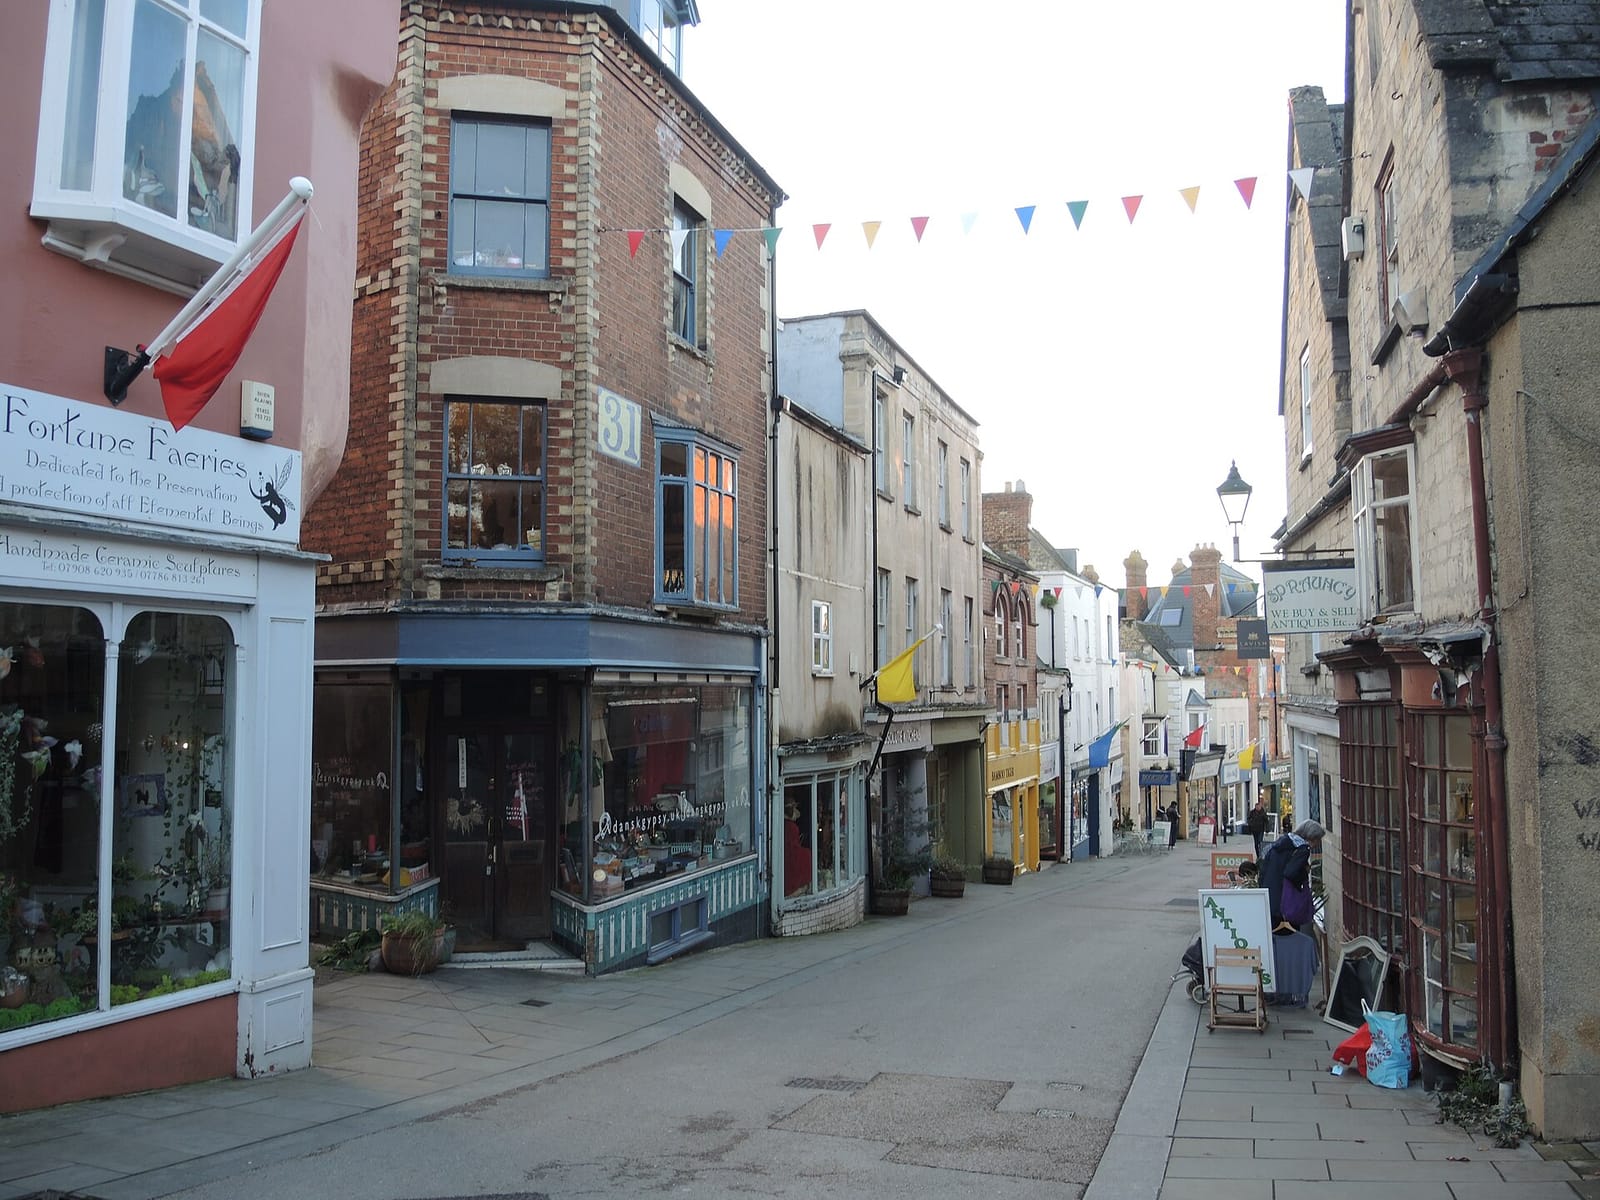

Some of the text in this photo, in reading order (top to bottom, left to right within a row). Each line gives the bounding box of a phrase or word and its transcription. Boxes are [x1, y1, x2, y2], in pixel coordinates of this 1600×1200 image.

[3, 394, 248, 479] Fortune Faeries
[603, 395, 638, 460] 31
[25, 448, 238, 503] Dedicated to the Preservation
[10, 479, 92, 505] protection
[95, 492, 111, 511] of
[112, 493, 133, 511] all
[140, 495, 212, 523] Elemental
[222, 509, 265, 534] Beings
[0, 535, 241, 577] Handmade Ceramic Sculptures
[58, 564, 91, 575] 07908
[1271, 607, 1356, 619] WE BUY & SELL
[1271, 618, 1329, 629] ANTIQUES
[612, 808, 680, 833] danskgypsy.uk
